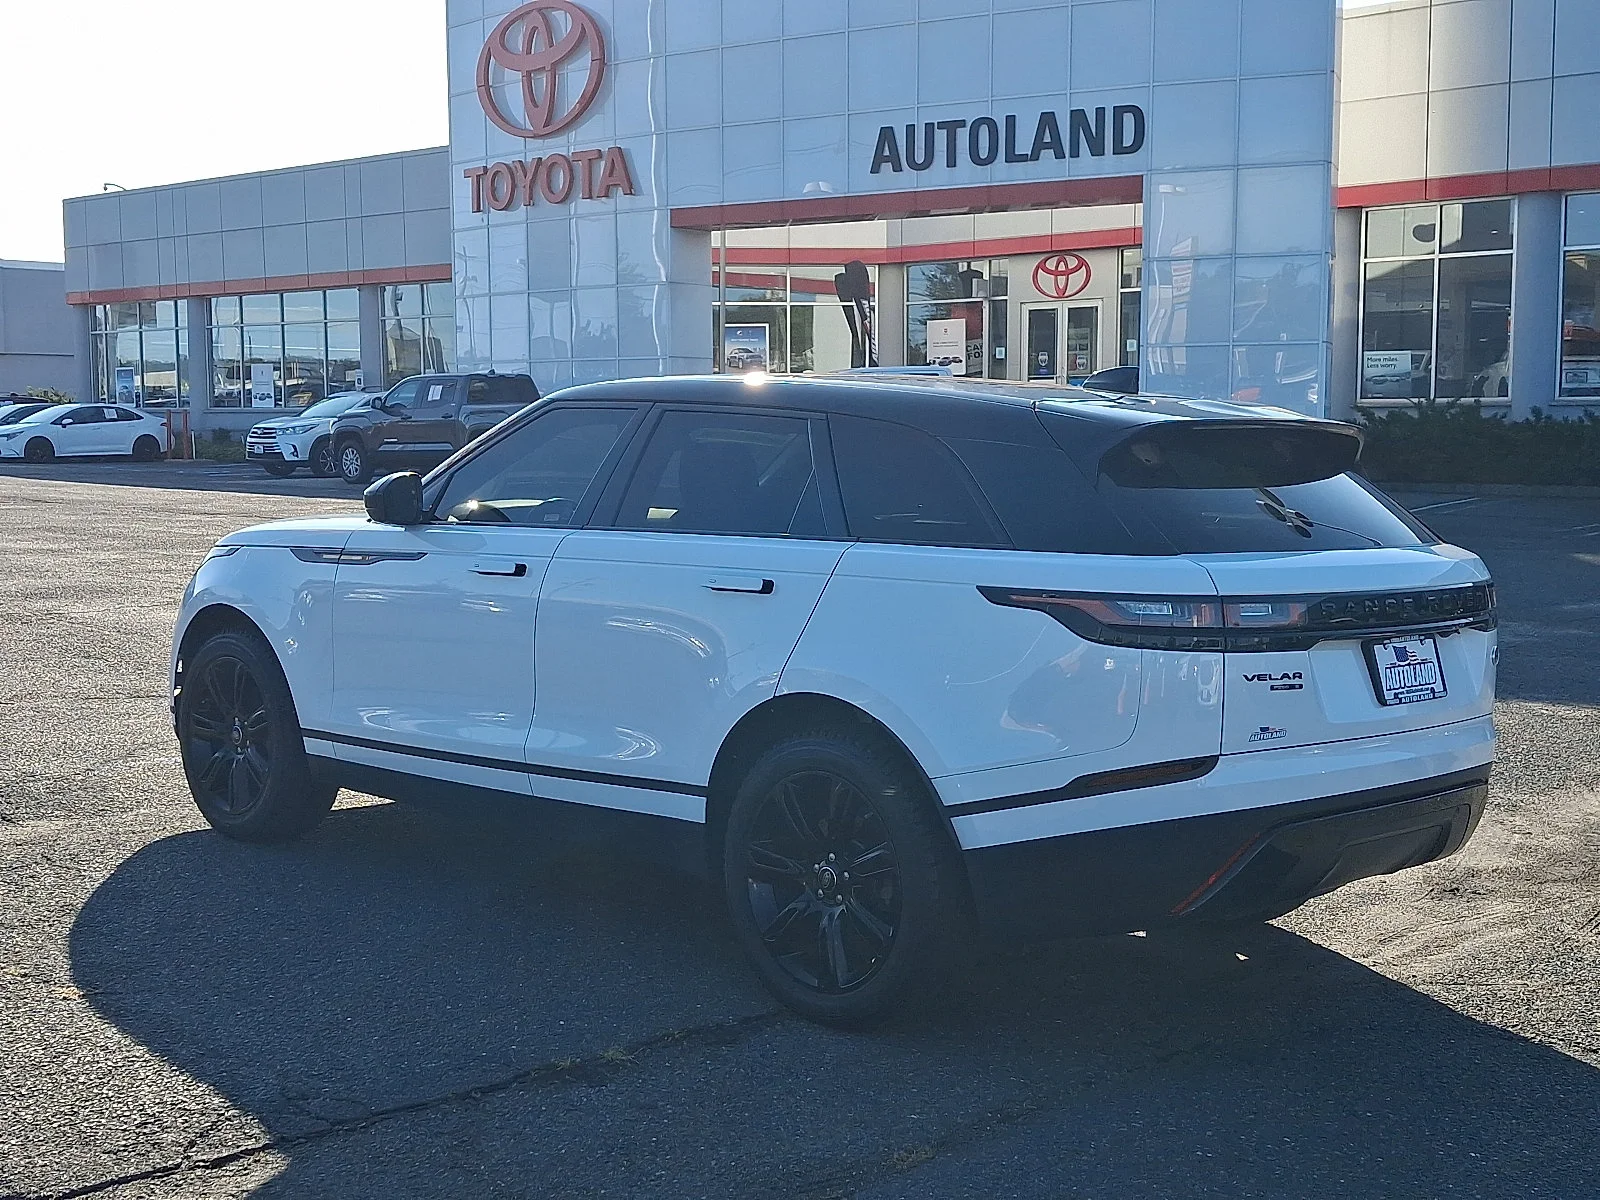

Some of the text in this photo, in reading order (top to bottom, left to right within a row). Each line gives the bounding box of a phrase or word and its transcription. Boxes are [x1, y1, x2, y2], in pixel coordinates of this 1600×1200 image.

[870, 104, 1146, 174] AUTOLAND
[463, 146, 635, 213] TOYOTA
[1321, 598, 1413, 616] RANGE
[1242, 672, 1303, 682] VELAR
[1385, 663, 1436, 691] AUTOLAND
[1401, 694, 1433, 703] AUTOLAND
[1249, 730, 1287, 742] AUTOLAND
